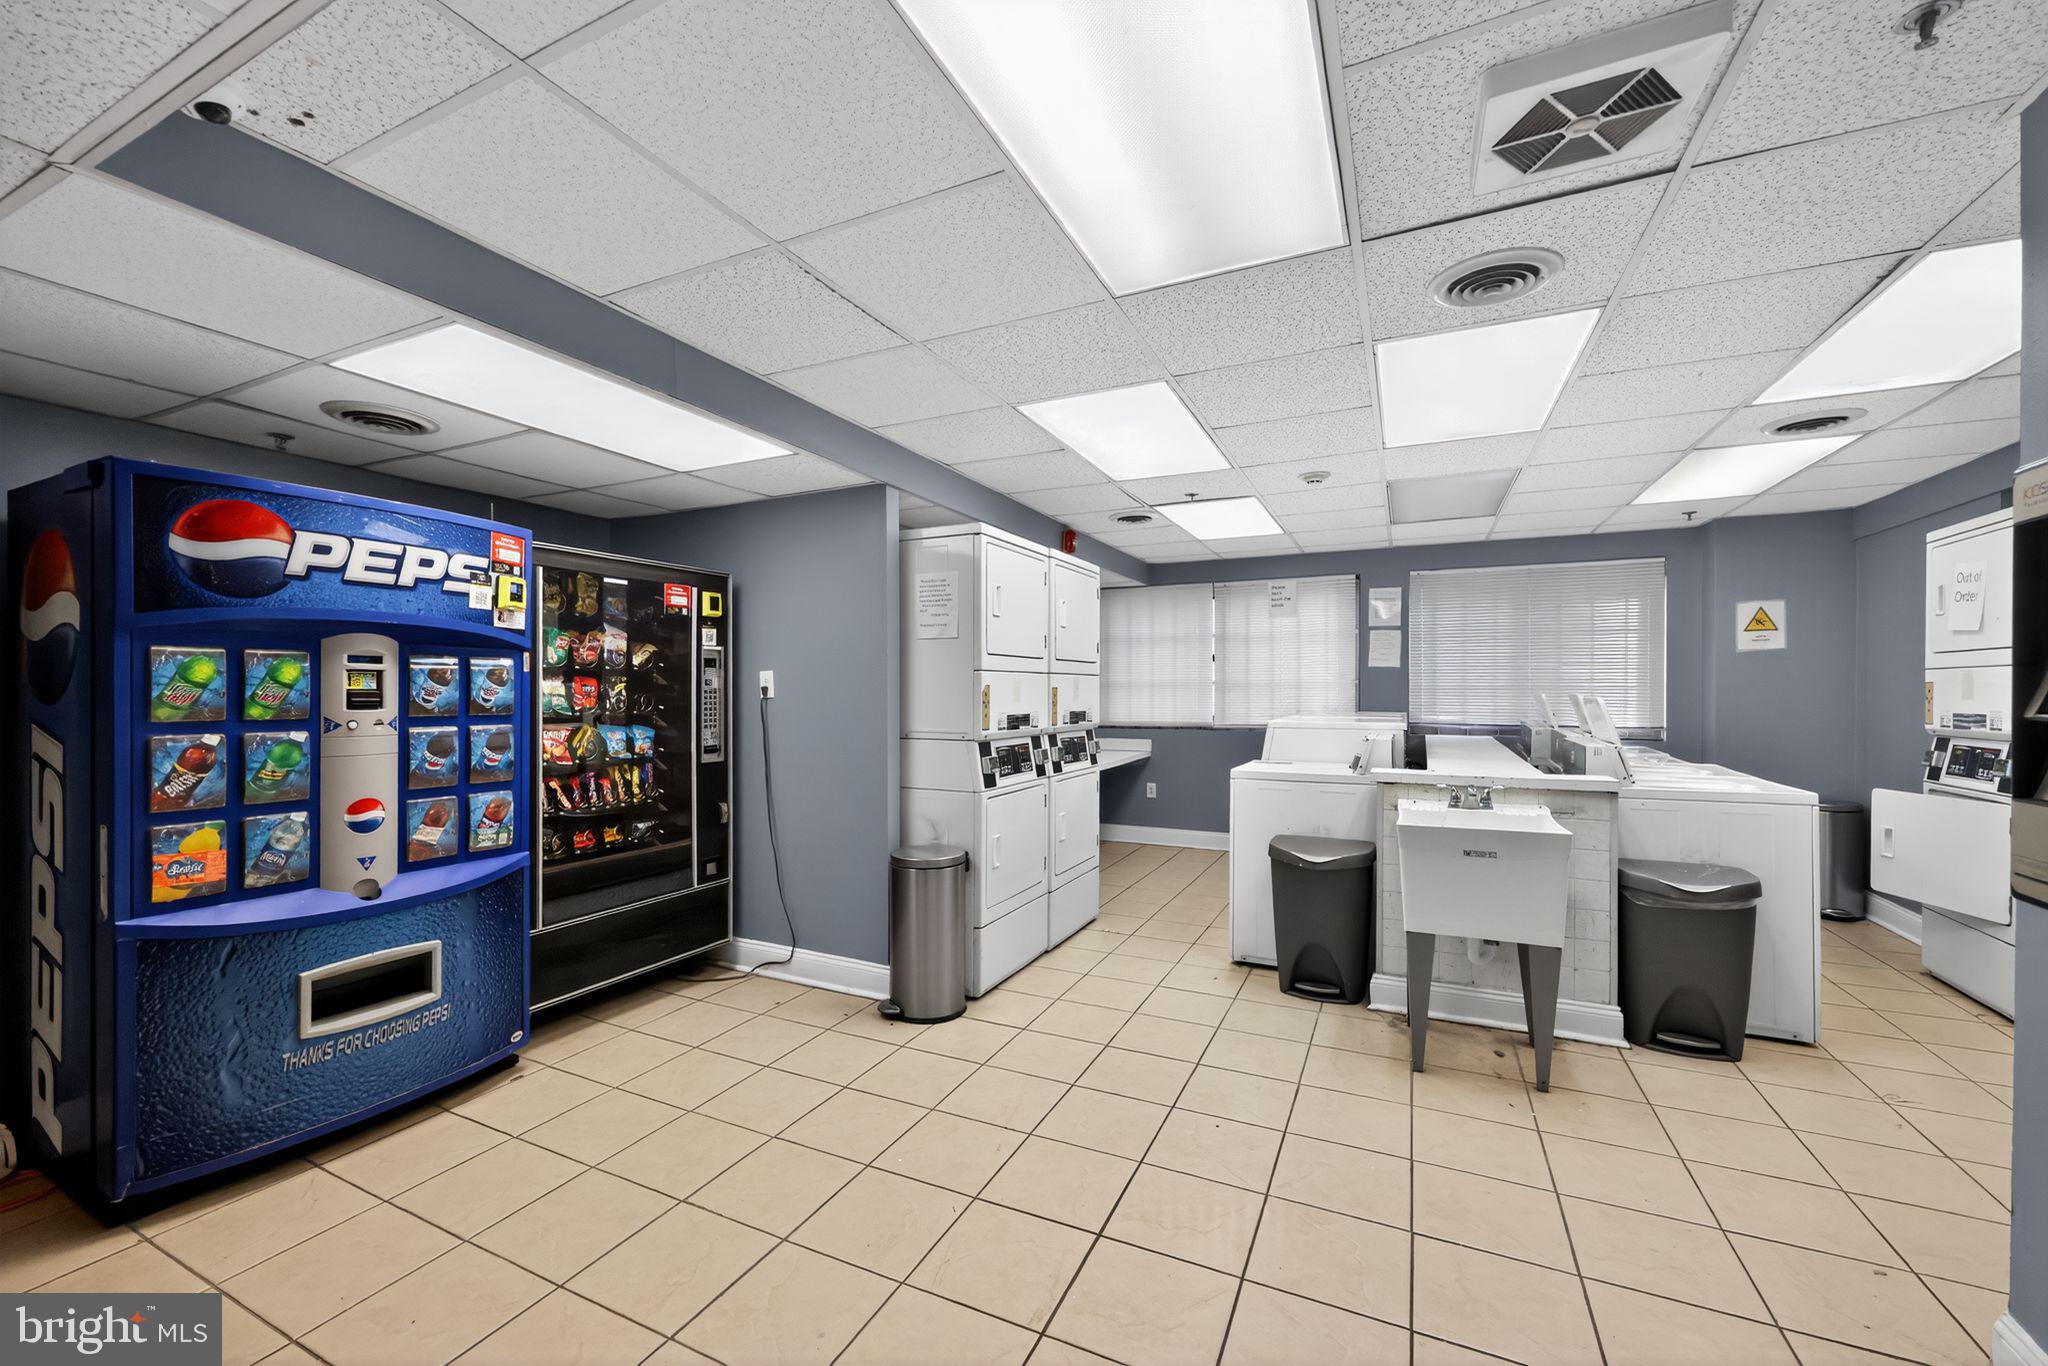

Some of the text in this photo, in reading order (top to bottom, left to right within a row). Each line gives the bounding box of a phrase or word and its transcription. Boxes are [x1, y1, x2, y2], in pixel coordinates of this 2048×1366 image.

[284, 530, 498, 593] PEPS
[31, 723, 64, 1157] PEPSI
[282, 1002, 452, 1072] THANKS FOR CHOOSING PEPSI
